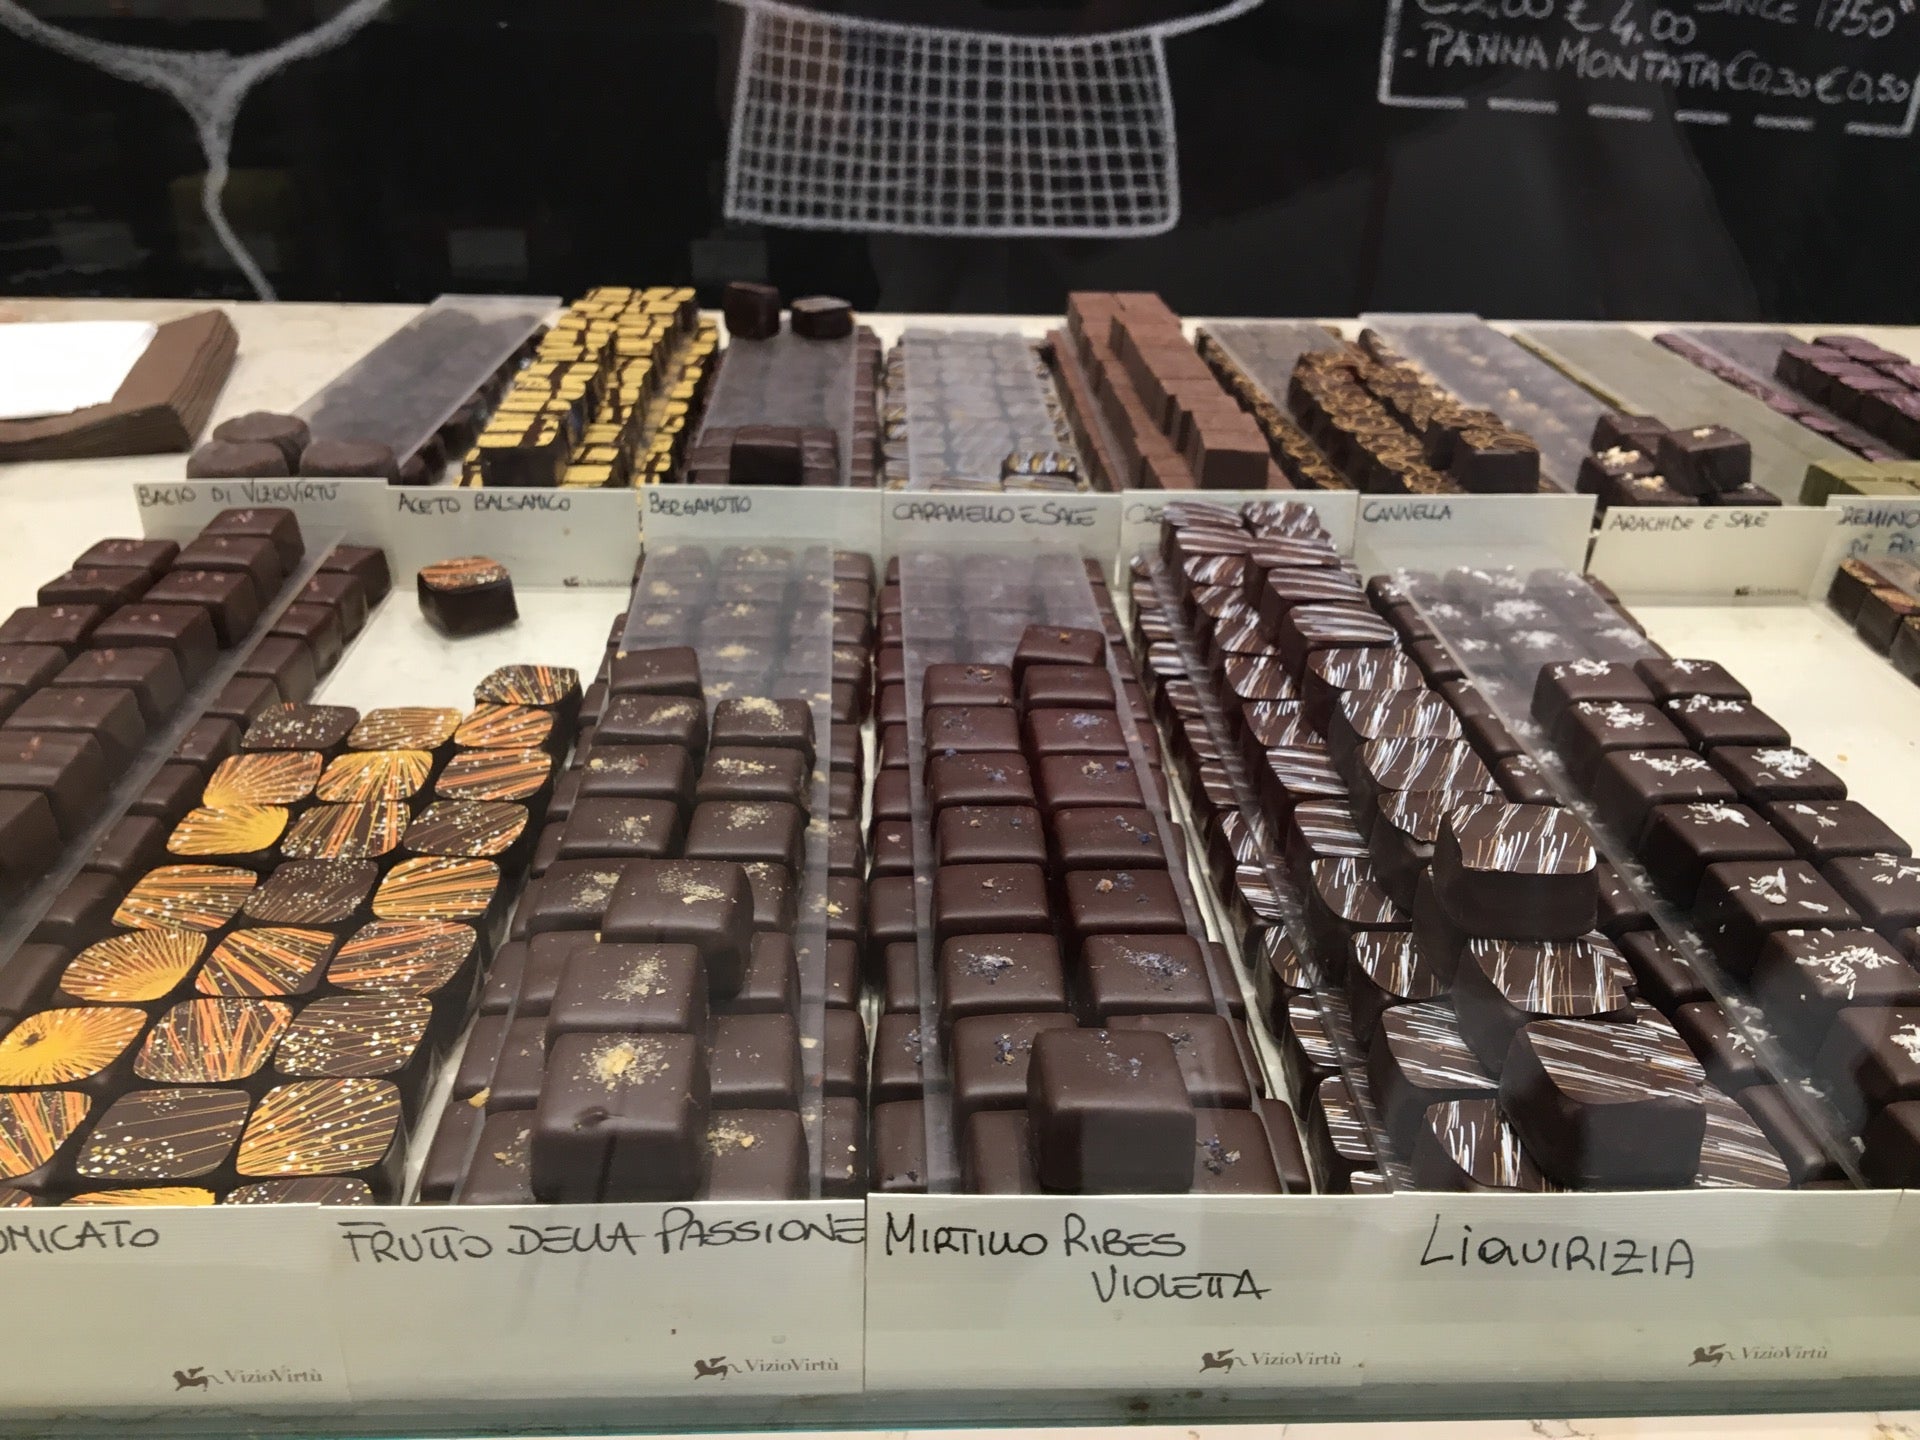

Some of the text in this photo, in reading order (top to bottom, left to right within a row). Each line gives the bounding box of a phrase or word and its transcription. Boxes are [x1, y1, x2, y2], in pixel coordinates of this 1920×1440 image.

[1556, 37, 1720, 91] MONTATA
[138, 485, 197, 507] BACIO
[211, 486, 233, 504] DI
[399, 492, 572, 515] ACETO BALSAMICO
[649, 491, 752, 516] BERGAMOTTO
[892, 502, 1016, 524] CARAMELLO
[1362, 501, 1452, 522] CANNELLA
[337, 1206, 867, 1263] FRUTTO DELLA PASSIONE
[885, 1211, 1187, 1257] MIRTILLO RIBES
[1092, 1264, 1272, 1303] VIOLETTA
[1251, 1351, 1342, 1366] VizioVirtù
[1741, 1345, 1829, 1361] VizioVirtù
[224, 1366, 324, 1384] VizioVirtù
[744, 1357, 840, 1373] VizioVirtù
